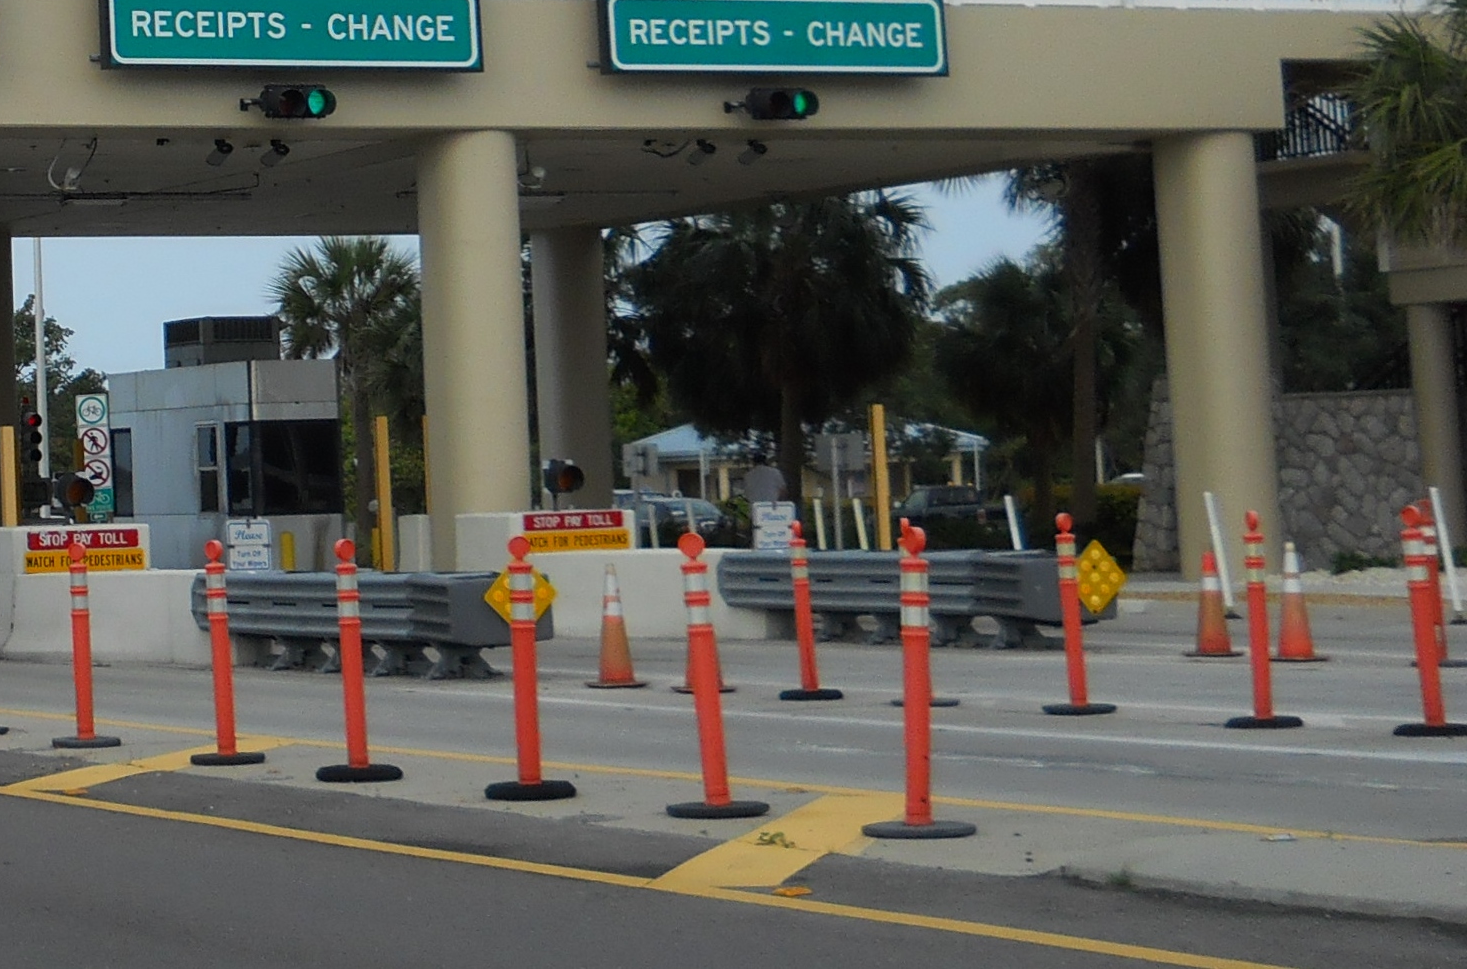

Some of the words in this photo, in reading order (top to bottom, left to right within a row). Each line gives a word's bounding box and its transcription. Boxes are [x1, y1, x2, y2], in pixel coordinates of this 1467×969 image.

[132, 10, 286, 39] RECEIPTS
[327, 13, 455, 42] CHANGE
[629, 18, 771, 46] RECEIPTS
[807, 21, 924, 48] CHANGE
[533, 516, 561, 528] STOP
[564, 515, 582, 527] PAY
[587, 514, 614, 526] TOLL
[39, 534, 68, 546] STOP
[73, 533, 93, 545] PAY
[98, 532, 128, 545] TOLL
[530, 537, 548, 548] ATCH
[553, 536, 569, 547] FOR
[574, 534, 628, 546] PEDESTRIANS
[26, 556, 55, 568] WATCH
[83, 553, 143, 567] PEDESTRIANS
